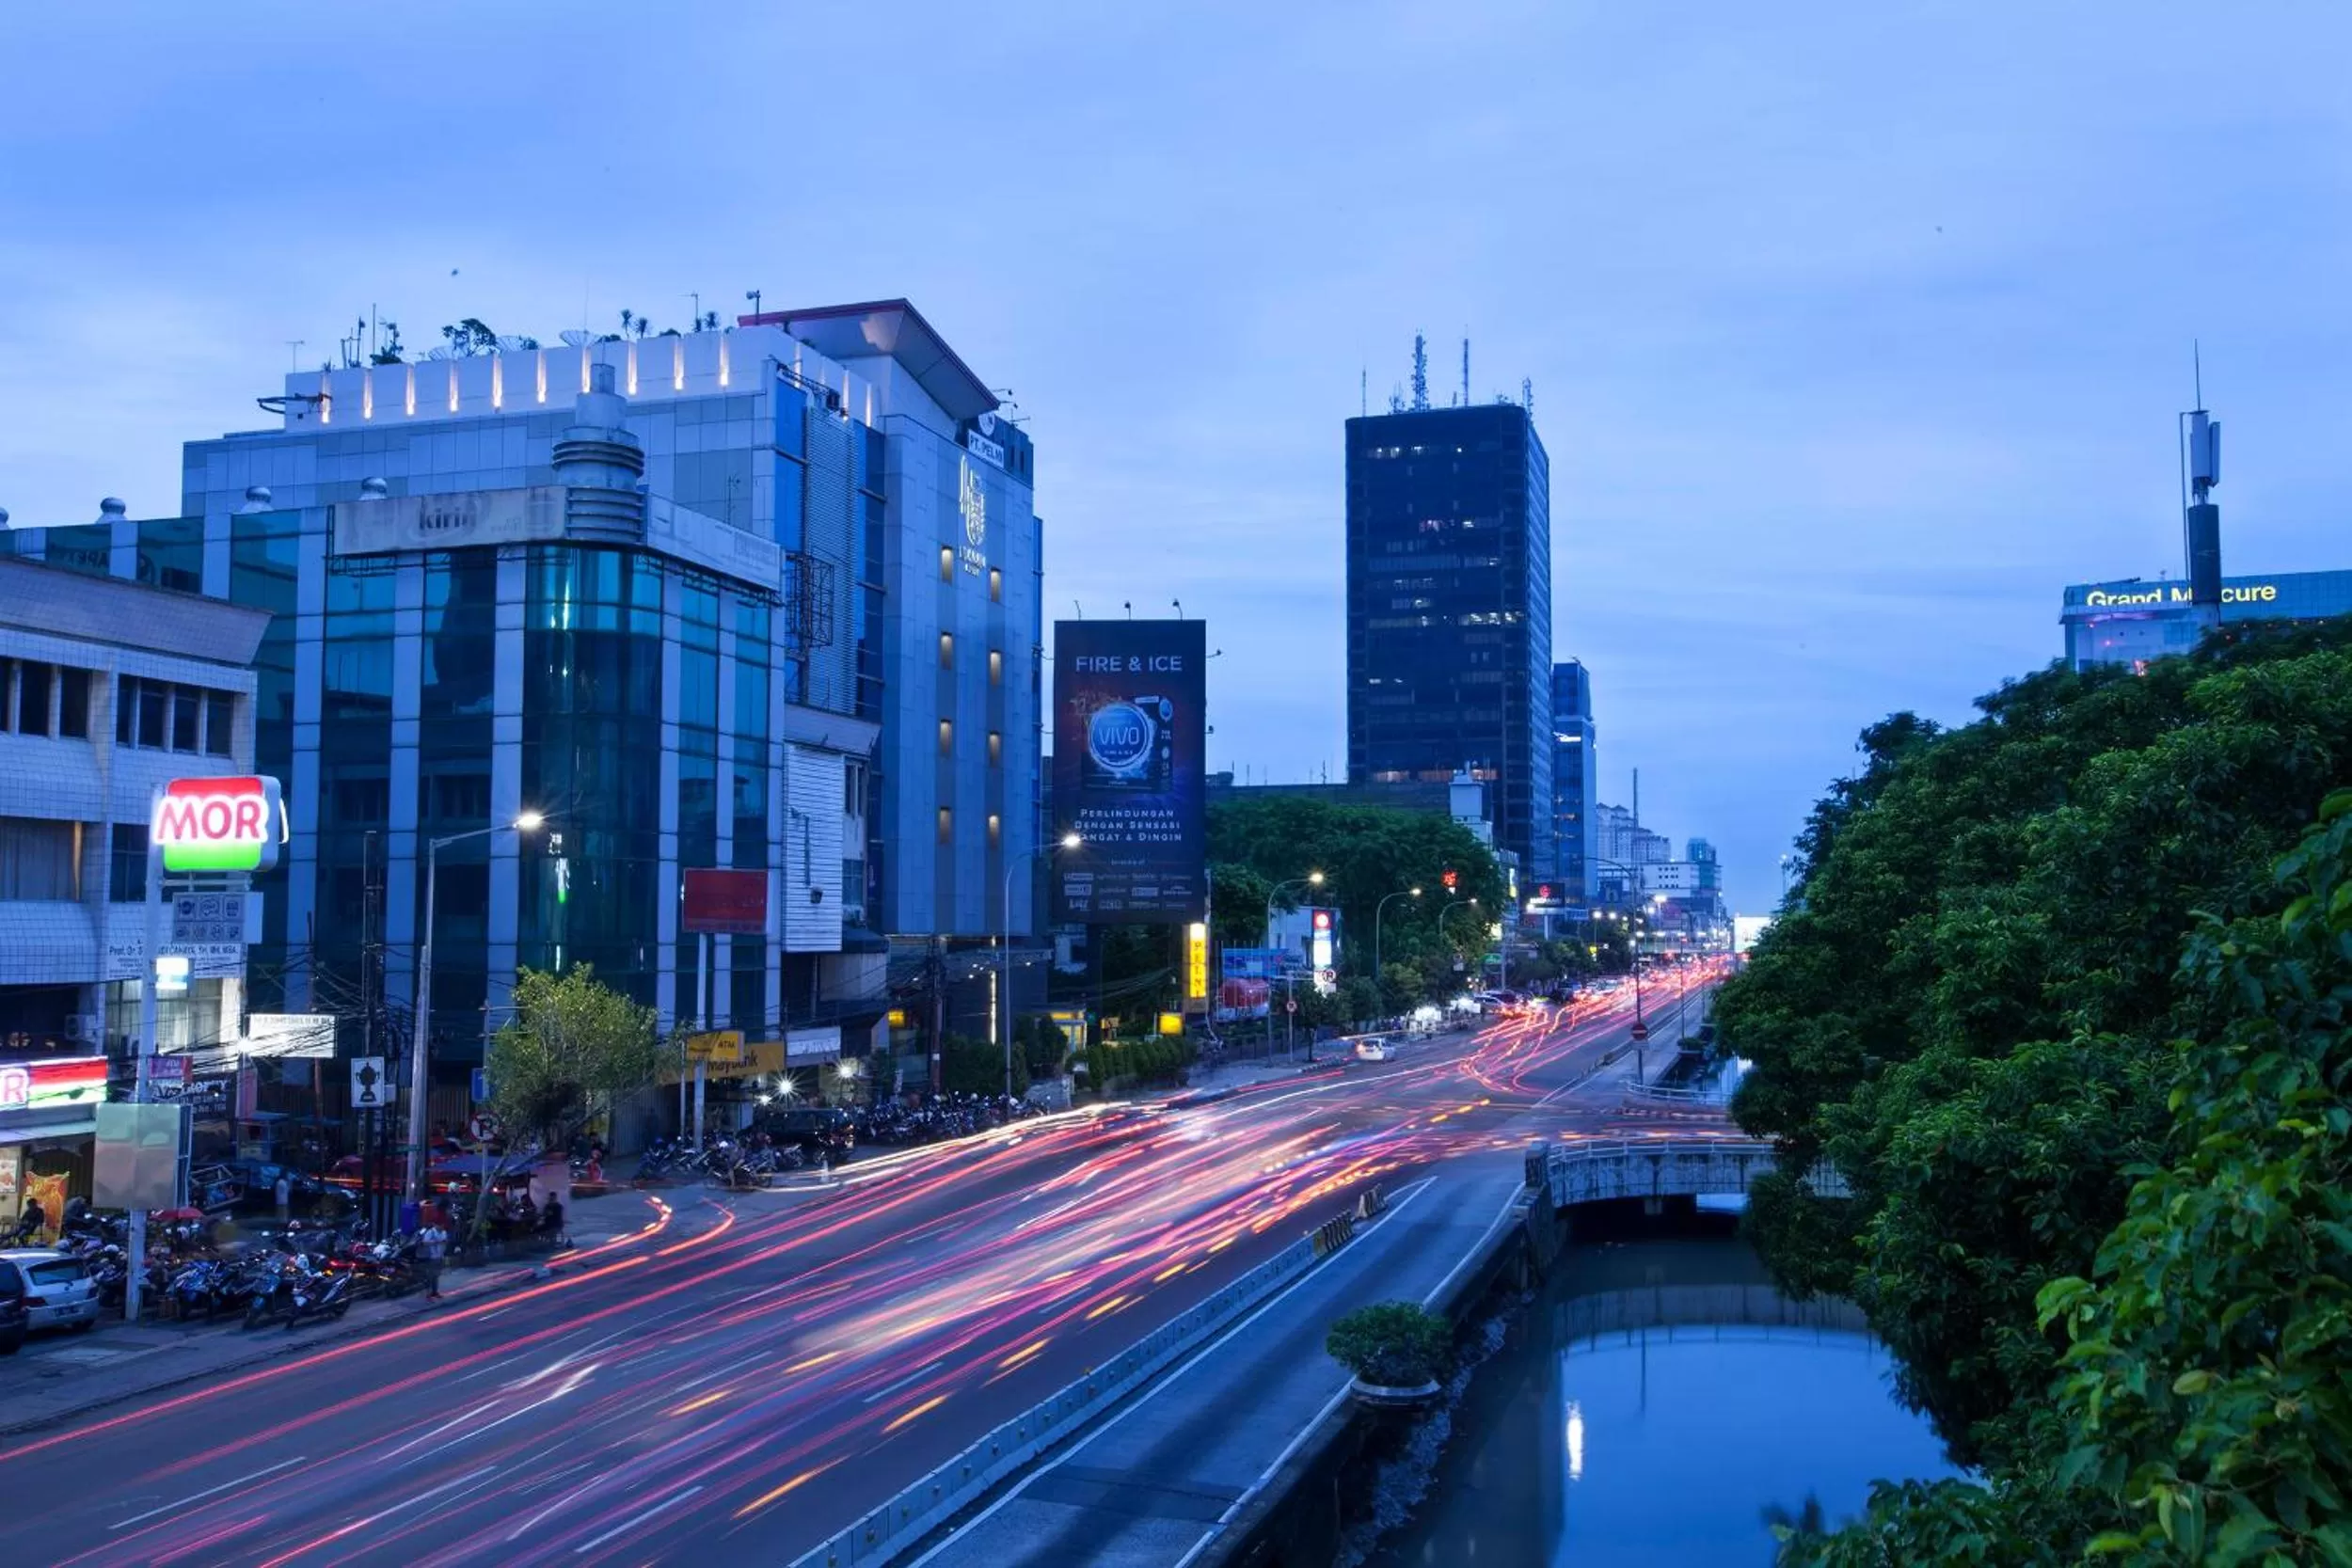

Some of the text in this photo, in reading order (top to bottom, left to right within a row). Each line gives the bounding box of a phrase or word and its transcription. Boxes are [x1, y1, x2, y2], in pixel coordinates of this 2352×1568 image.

[2087, 584, 2276, 607] Grand Mcure
[1075, 655, 1183, 673] FIRE & ICE
[1098, 726, 1140, 746] VIVO
[158, 800, 262, 840] MOR
[1080, 808, 1174, 817] PERLINDUNGAN
[1074, 820, 1181, 830] DENGAN SENSASI
[1076, 832, 1120, 842] ANGAT
[1138, 832, 1182, 842] DINGIN
